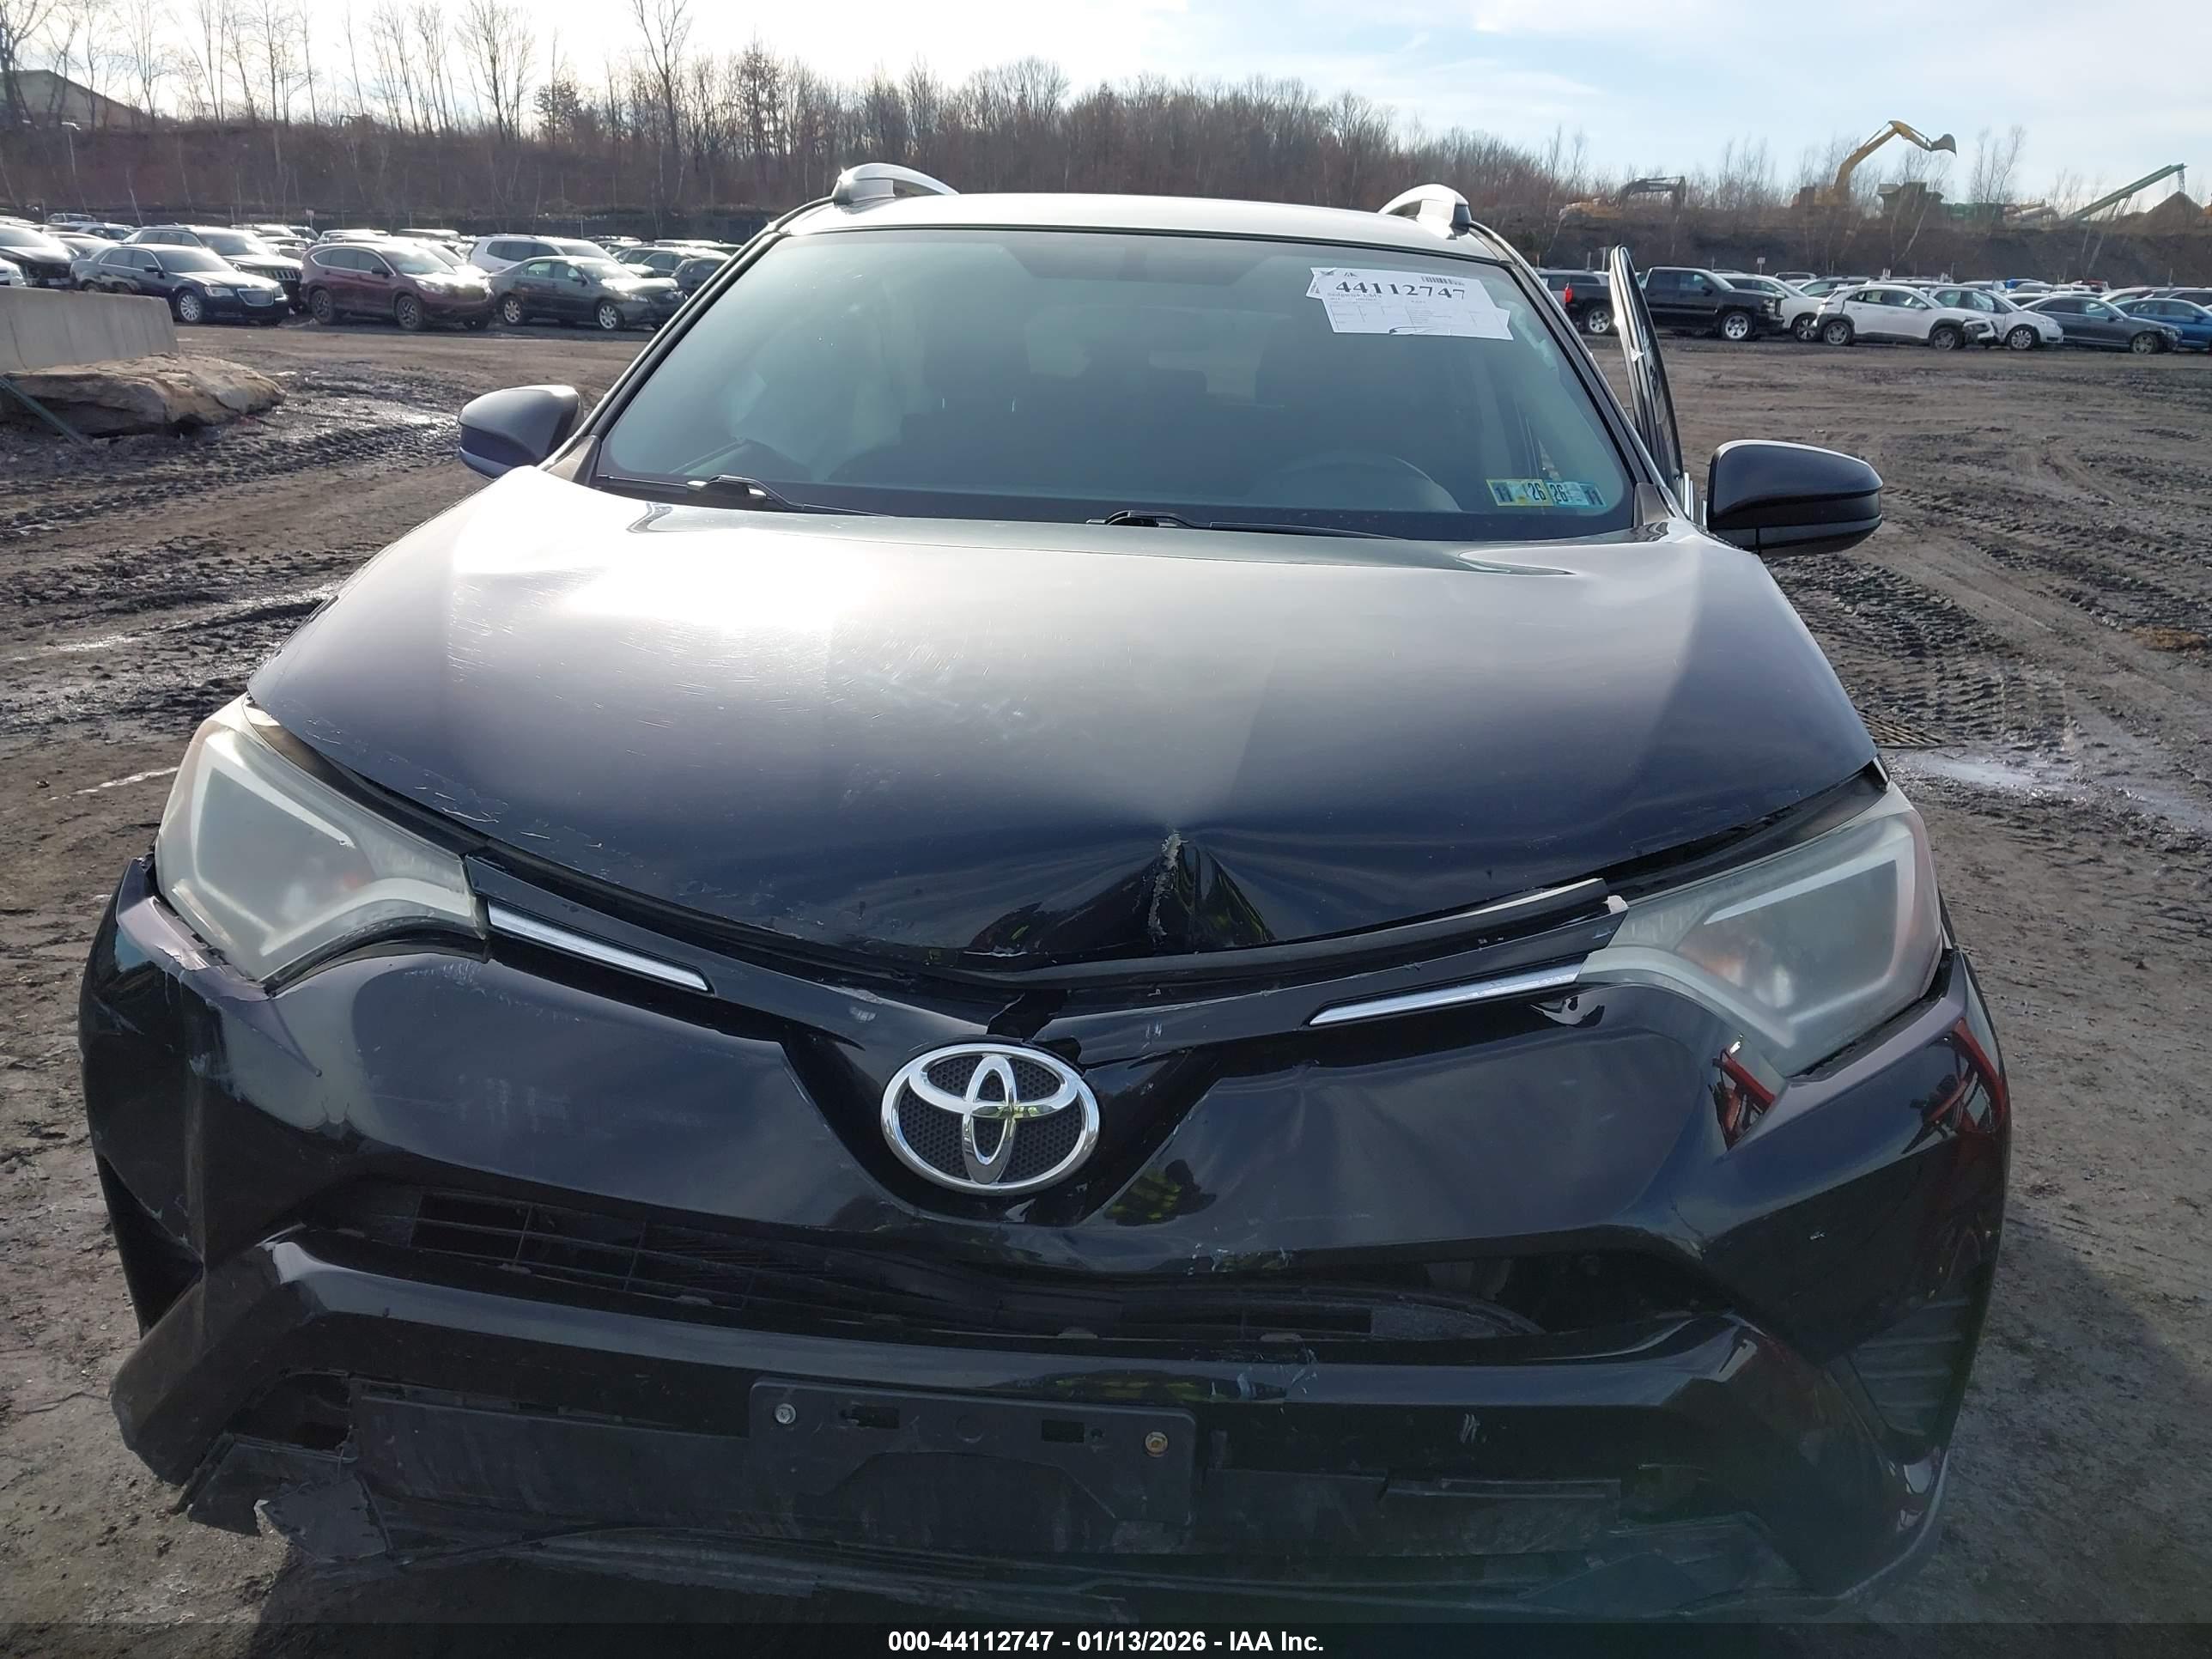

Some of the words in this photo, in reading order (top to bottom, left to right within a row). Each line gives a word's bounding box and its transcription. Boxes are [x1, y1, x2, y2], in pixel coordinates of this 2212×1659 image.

[1335, 281, 1465, 300] 44112747
[1528, 483, 1547, 501] 26
[1550, 484, 1569, 502] 26
